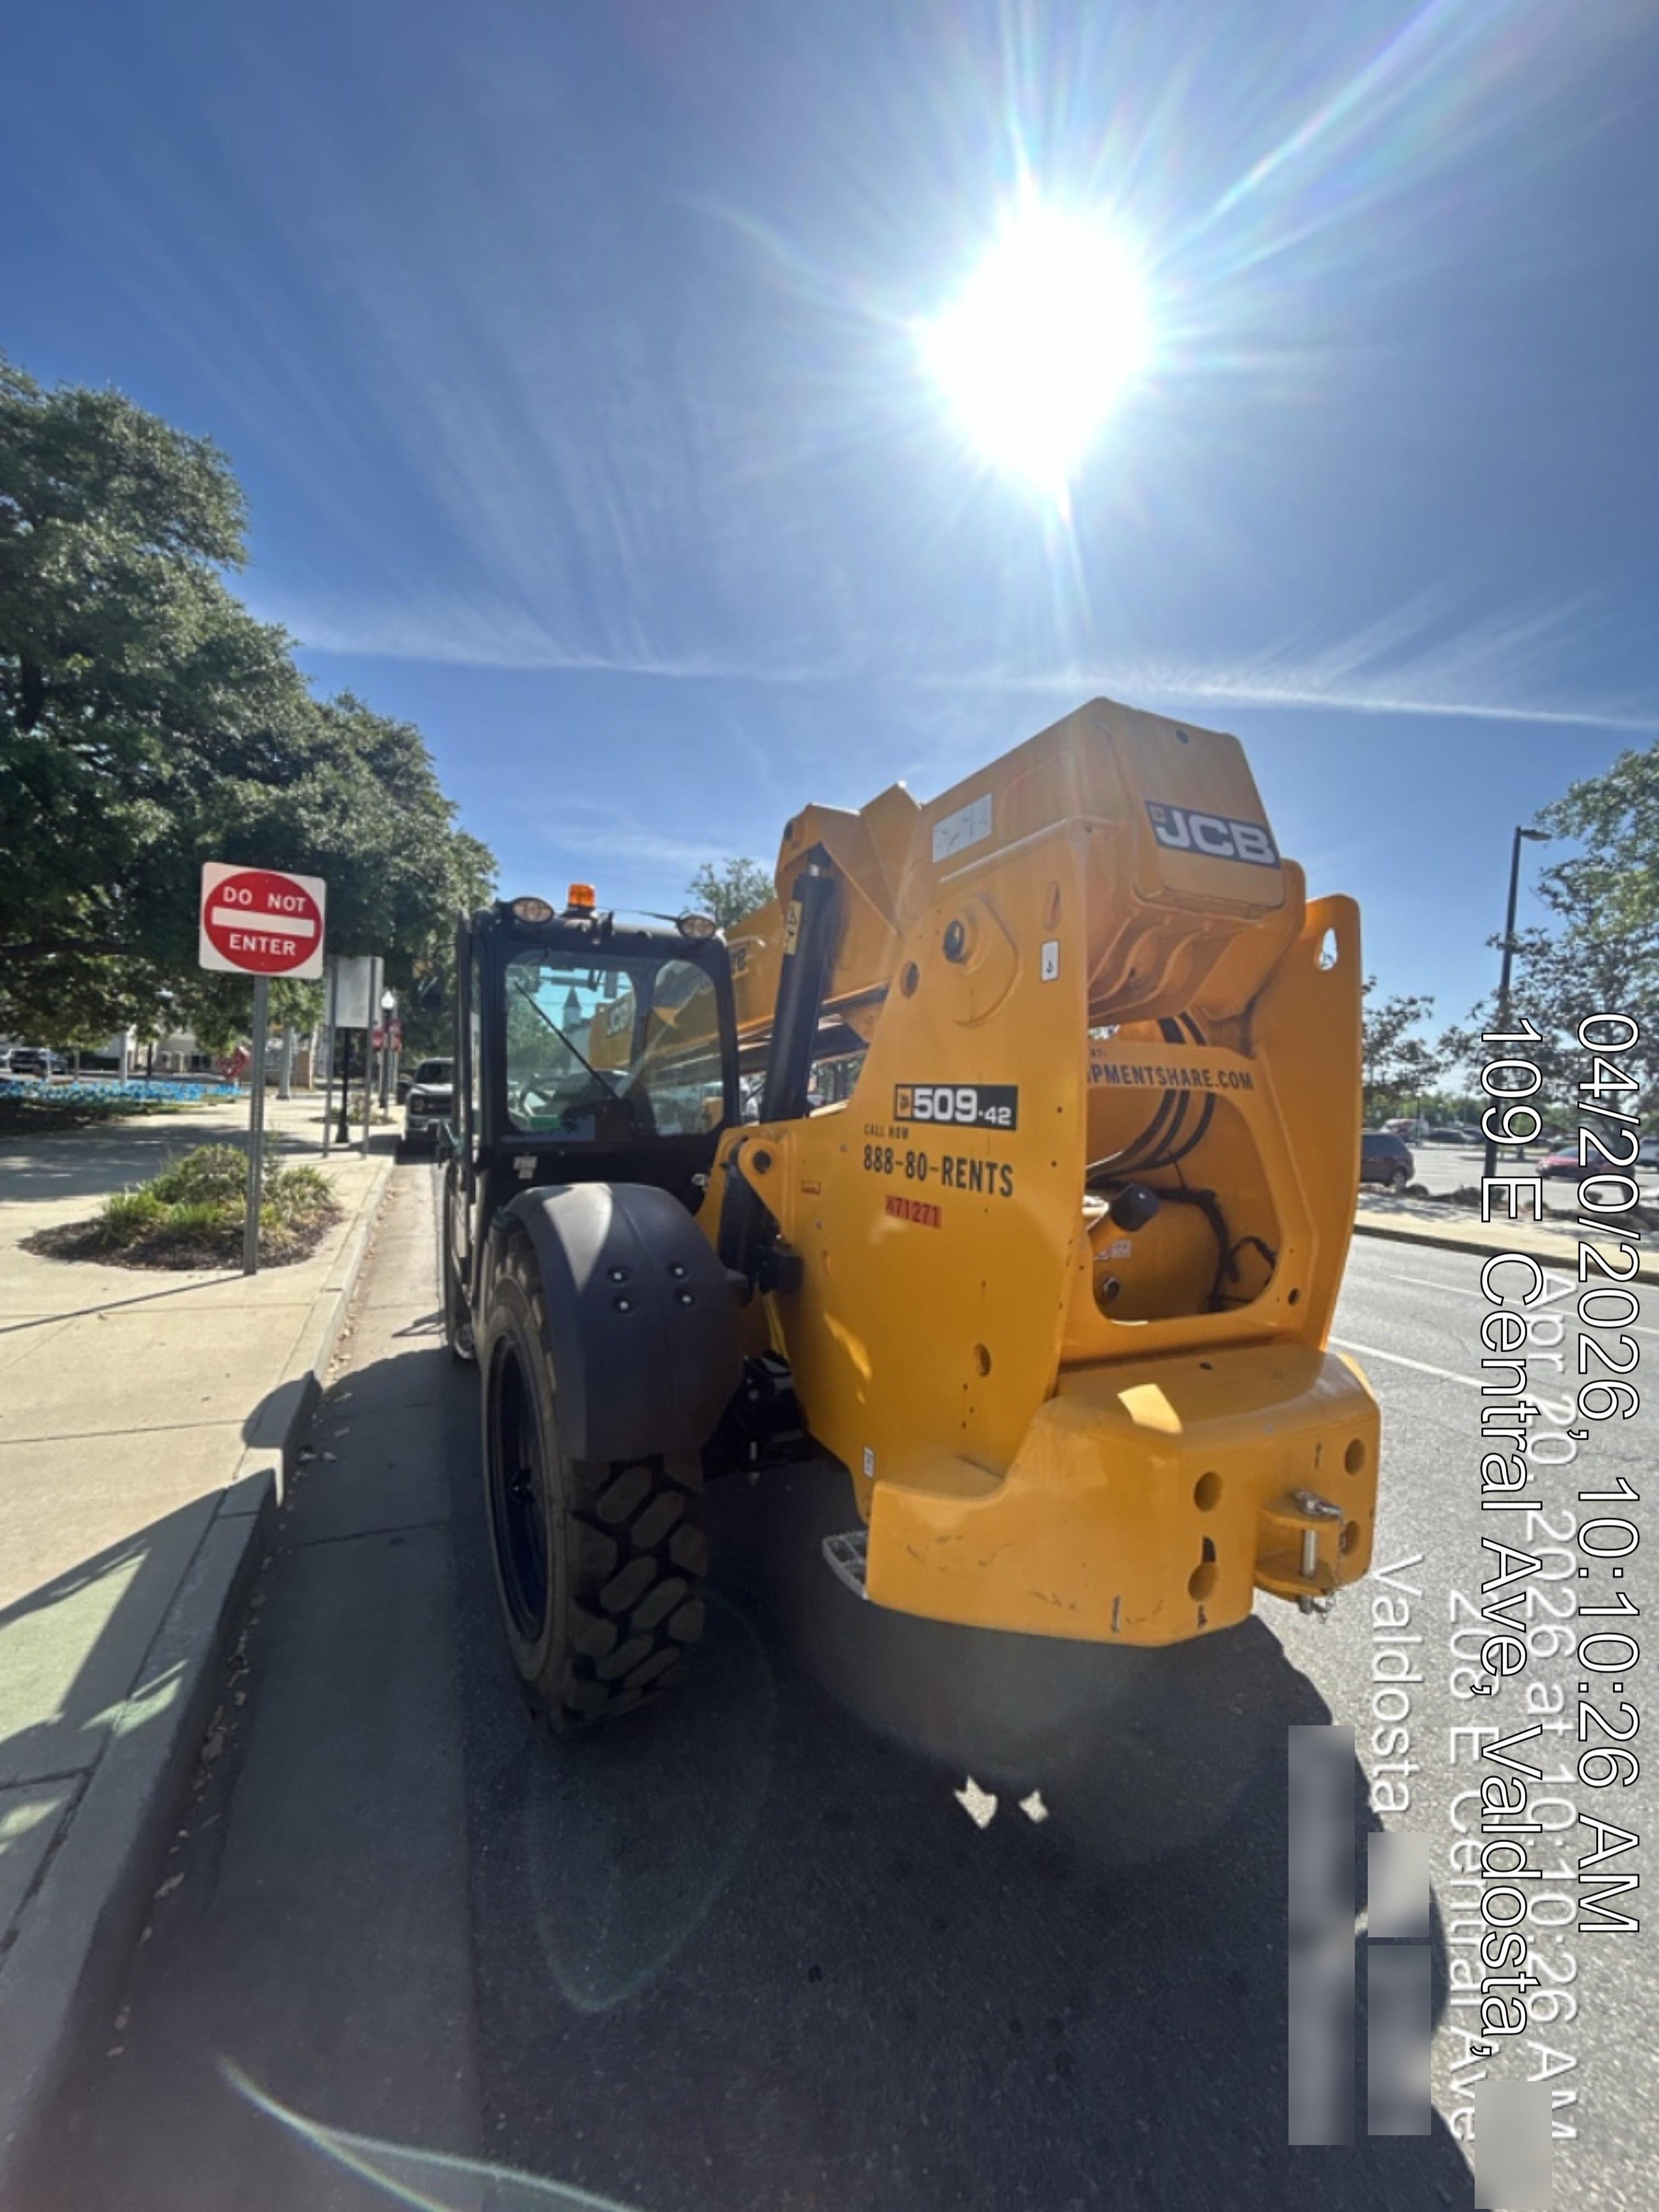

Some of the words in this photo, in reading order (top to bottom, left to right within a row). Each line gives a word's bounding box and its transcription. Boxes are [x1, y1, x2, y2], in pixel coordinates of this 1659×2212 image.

[1155, 810, 1277, 864] JCB
[222, 886, 253, 906] DO
[267, 892, 307, 912] NOT
[229, 933, 297, 956] ENTER
[1087, 1062, 1254, 1091] PMENTSHARE.COM
[864, 1123, 885, 1137] CALL
[863, 1145, 1013, 1198] 888-80-RENTS
